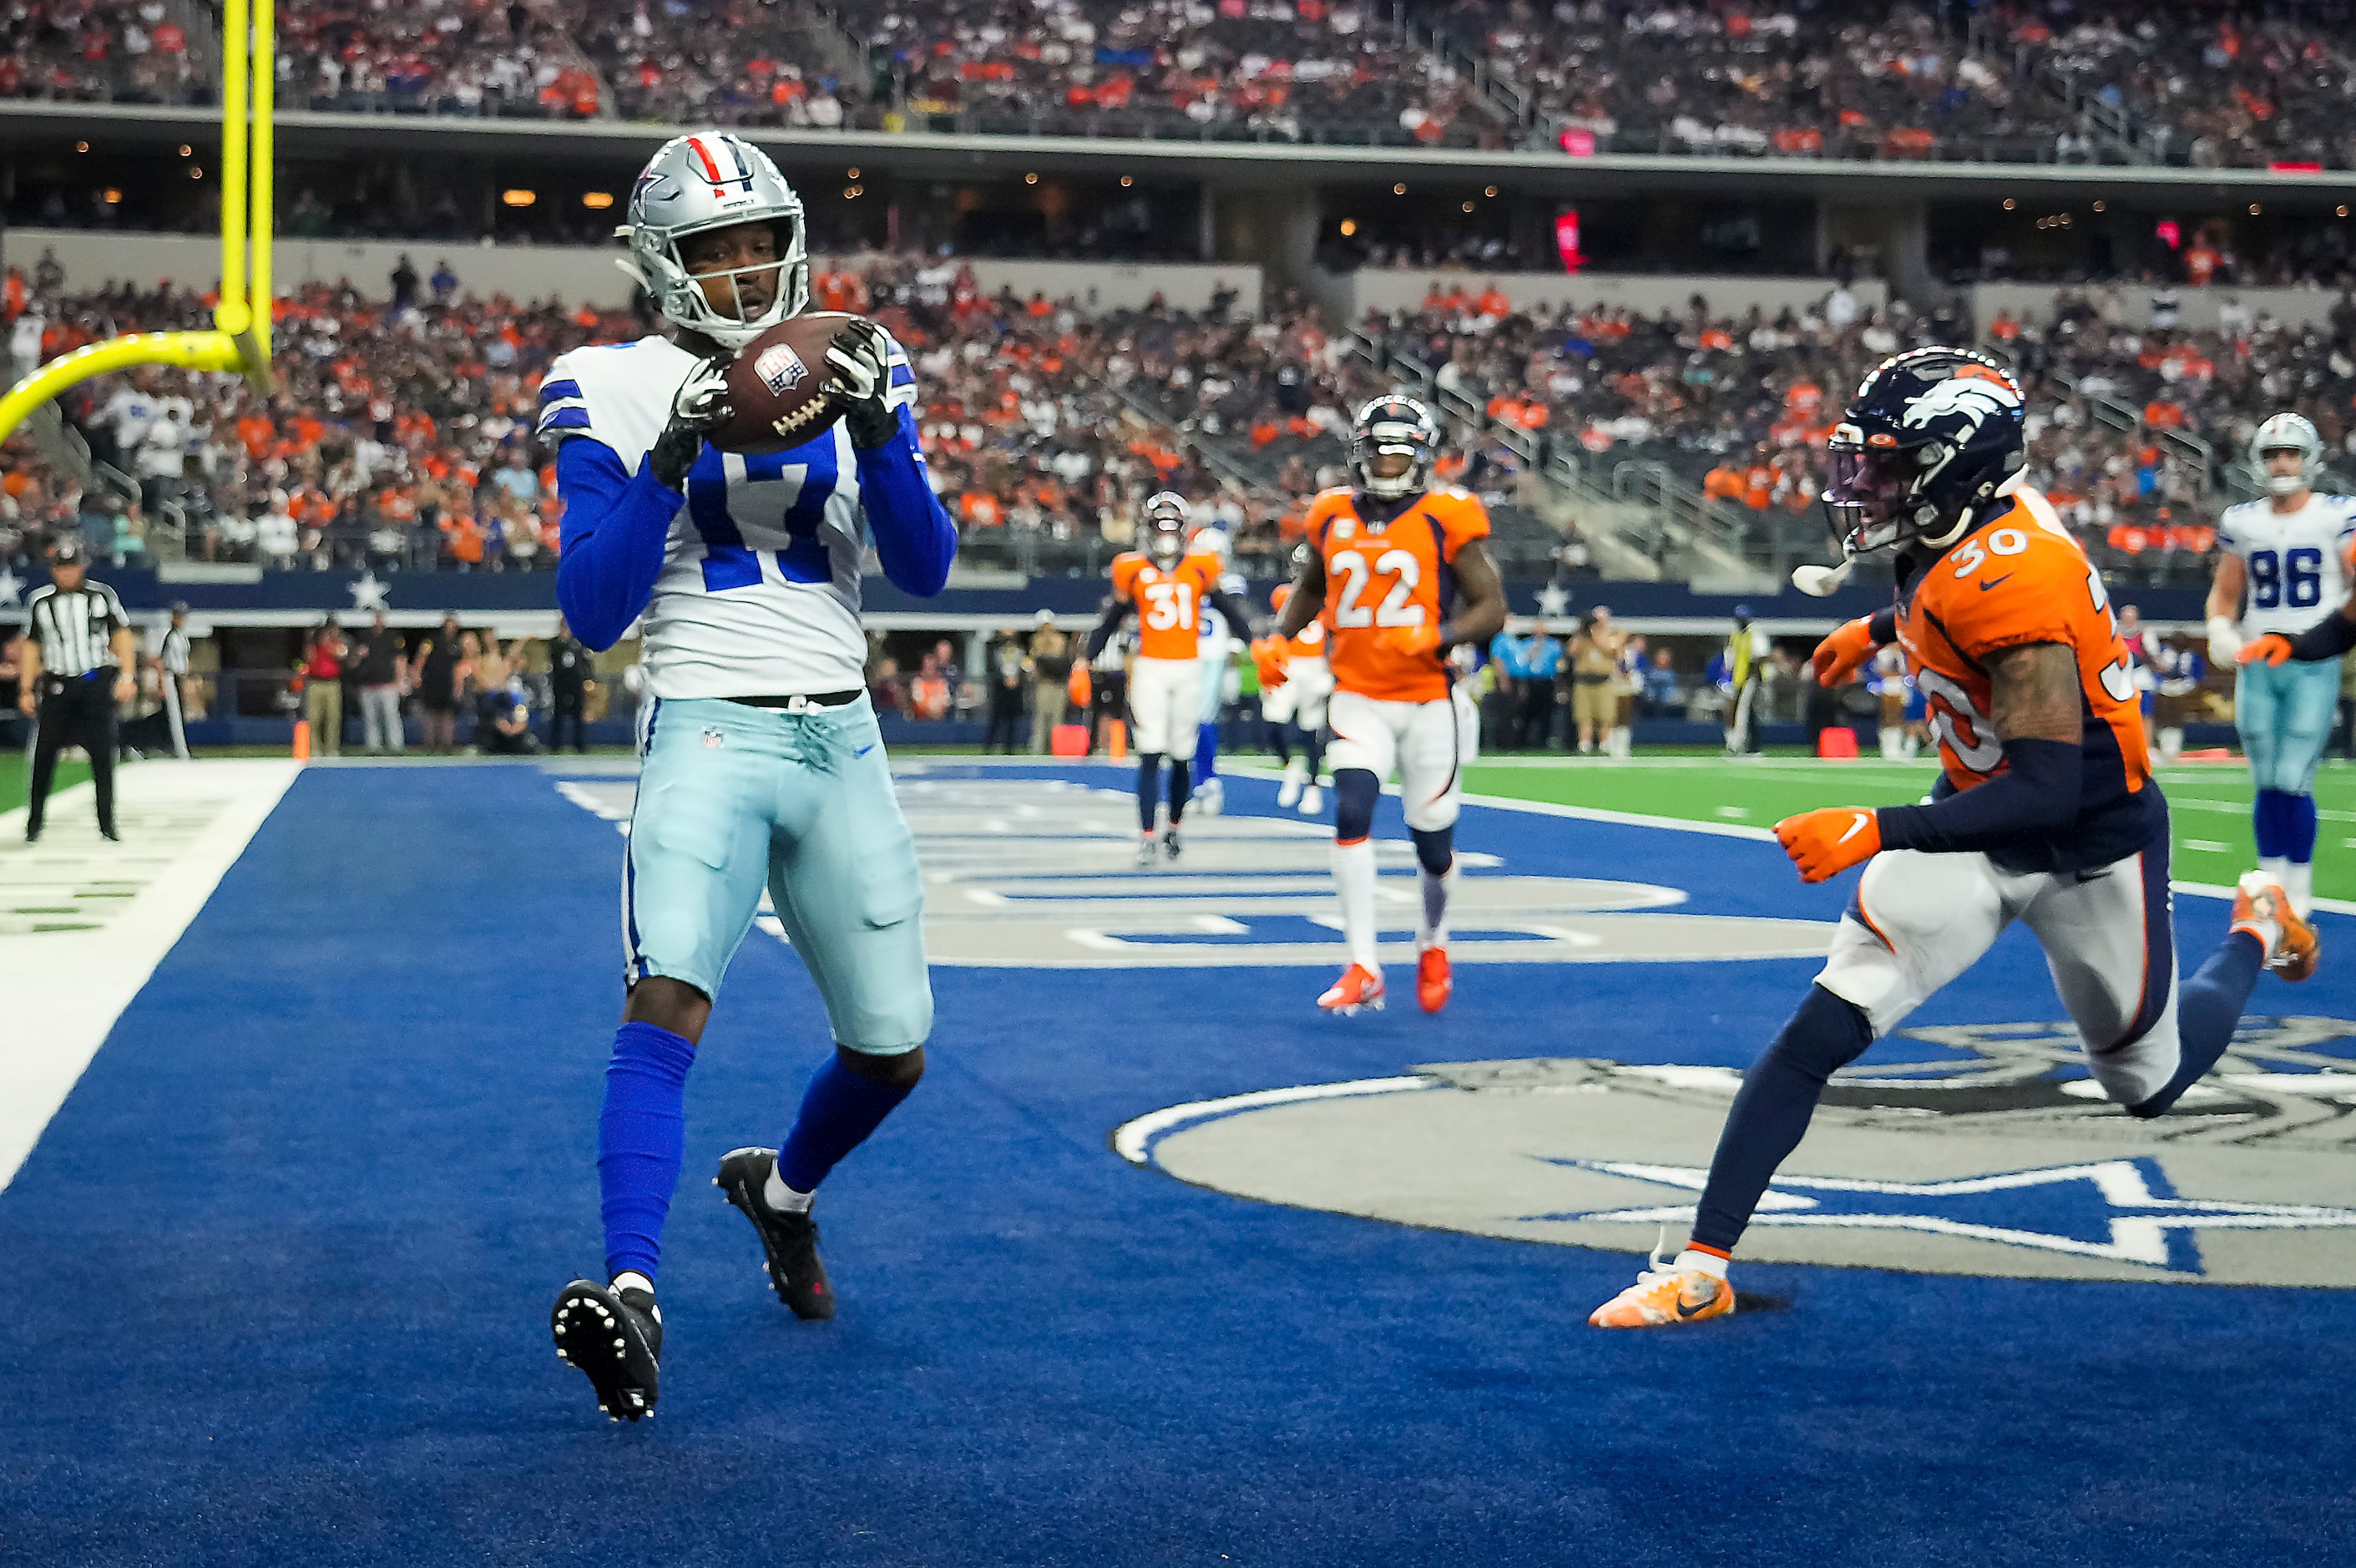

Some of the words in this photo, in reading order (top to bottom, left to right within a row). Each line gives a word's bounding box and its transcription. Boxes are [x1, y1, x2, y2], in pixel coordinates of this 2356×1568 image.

[688, 429, 838, 592] 17
[1949, 528, 2029, 579] 30
[1144, 583, 1194, 630] 31
[1331, 549, 1424, 628] 22
